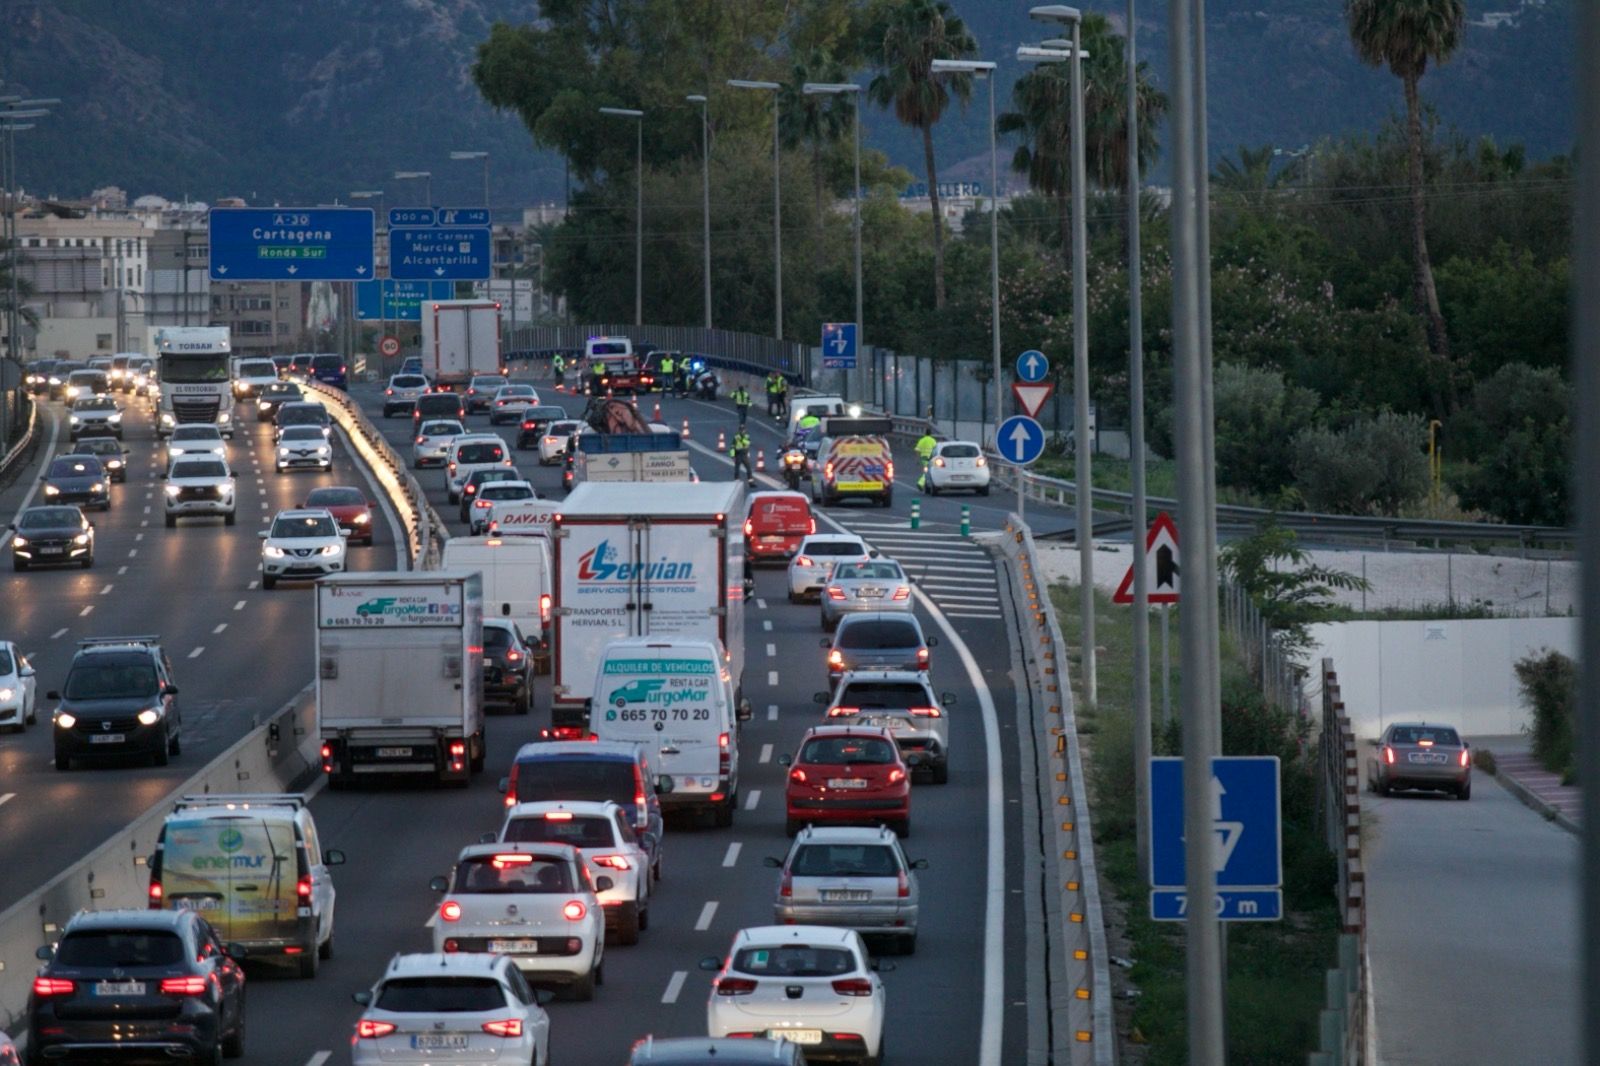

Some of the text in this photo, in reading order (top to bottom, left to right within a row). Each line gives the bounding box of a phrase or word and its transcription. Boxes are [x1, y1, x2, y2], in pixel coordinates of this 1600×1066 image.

[275, 214, 308, 225] A-30
[252, 228, 332, 242] Cartagena
[260, 247, 323, 257] Ronda Sur
[412, 243, 454, 252] Murcia
[403, 256, 478, 265] Alcantarilla
[408, 615, 454, 624] furgomar.es
[606, 660, 714, 672] ALQUILER DE VEHÍCULOS
[670, 678, 687, 688] RENT
[694, 678, 709, 687] CAR
[620, 709, 710, 721] 665 70 70 20
[192, 855, 266, 869] enermur
[1237, 899, 1258, 914] m
